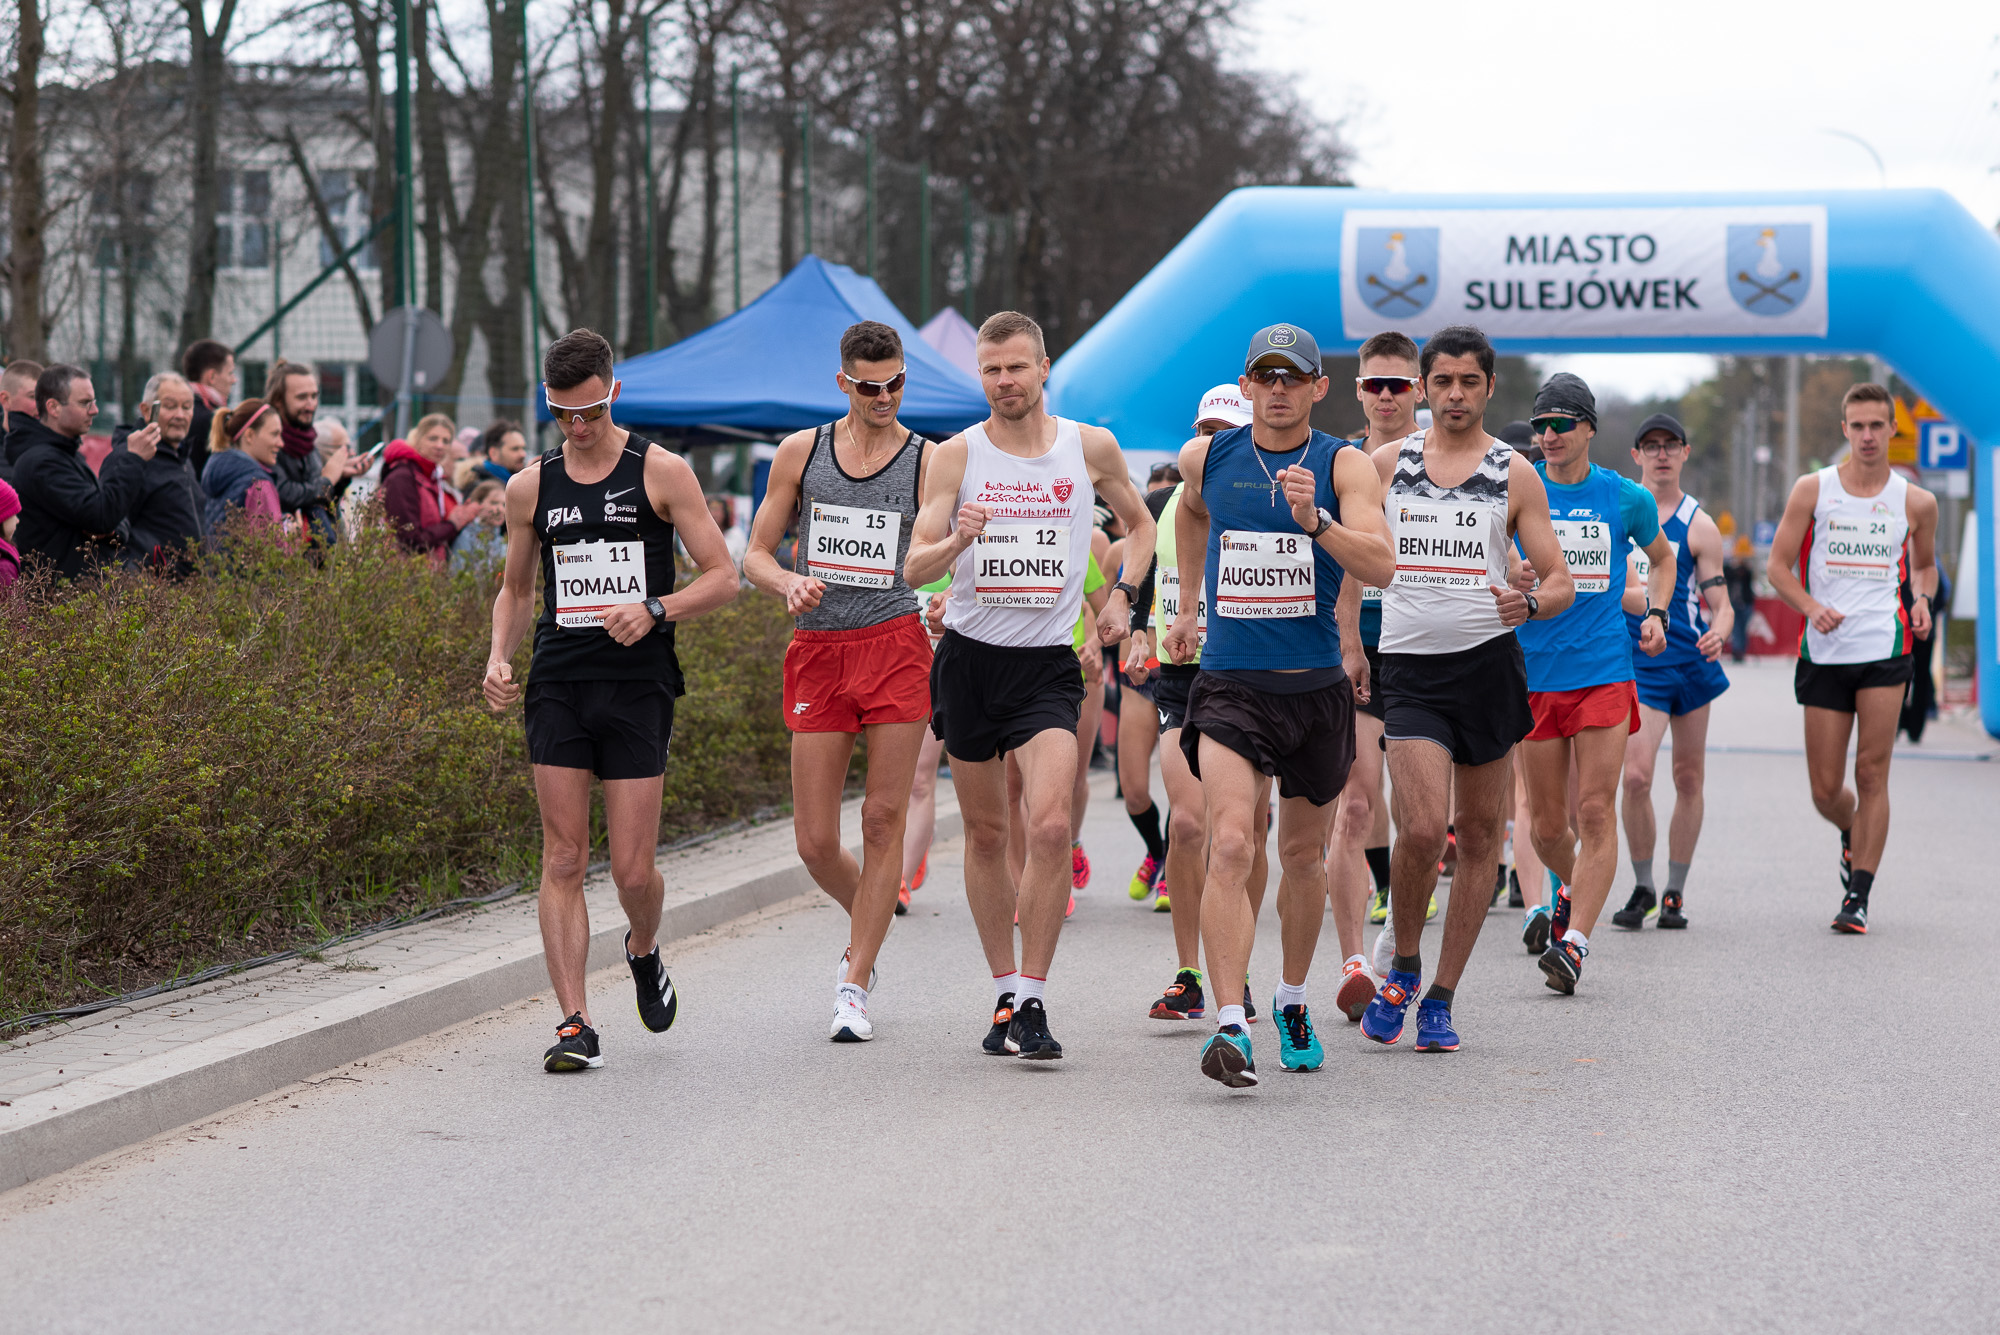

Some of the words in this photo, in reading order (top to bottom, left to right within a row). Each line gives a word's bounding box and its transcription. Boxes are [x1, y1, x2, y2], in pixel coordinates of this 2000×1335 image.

[1506, 235, 1656, 264] MIASTO
[1465, 269, 1700, 311] SULEJÓWEK
[1203, 397, 1240, 409] LATVIA
[1928, 426, 1959, 467] P
[1233, 482, 1281, 490] BRUBE
[608, 515, 637, 523] OPOLSKIE
[866, 513, 886, 529] 15
[1455, 511, 1477, 527] 16
[1581, 525, 1599, 539] 13
[1870, 522, 1886, 534] 24
[1035, 529, 1056, 546] 12
[1275, 537, 1297, 554] 18
[609, 546, 631, 563] 11
[817, 536, 886, 560] SIKORA
[1399, 537, 1429, 556] BEN
[1432, 538, 1485, 560] HLIMA
[1828, 541, 1892, 558] GOŁAWSKI
[1562, 550, 1607, 566] ZOWSKI
[979, 558, 1065, 578] JELONEK
[812, 570, 856, 583] SULEJÓWEK
[858, 576, 879, 585] 2022
[1221, 566, 1312, 587] AUGUSTYN
[1399, 573, 1447, 584] SULEJÓWEK
[1449, 577, 1470, 586] 2022
[560, 575, 641, 598] TOMALA
[982, 594, 1032, 605] SULEJÓWEK
[1034, 596, 1055, 605] 2022
[1221, 605, 1273, 615] SULEJÓWEK
[1276, 606, 1299, 615] 2022
[561, 615, 605, 625] SULEJÓWE
